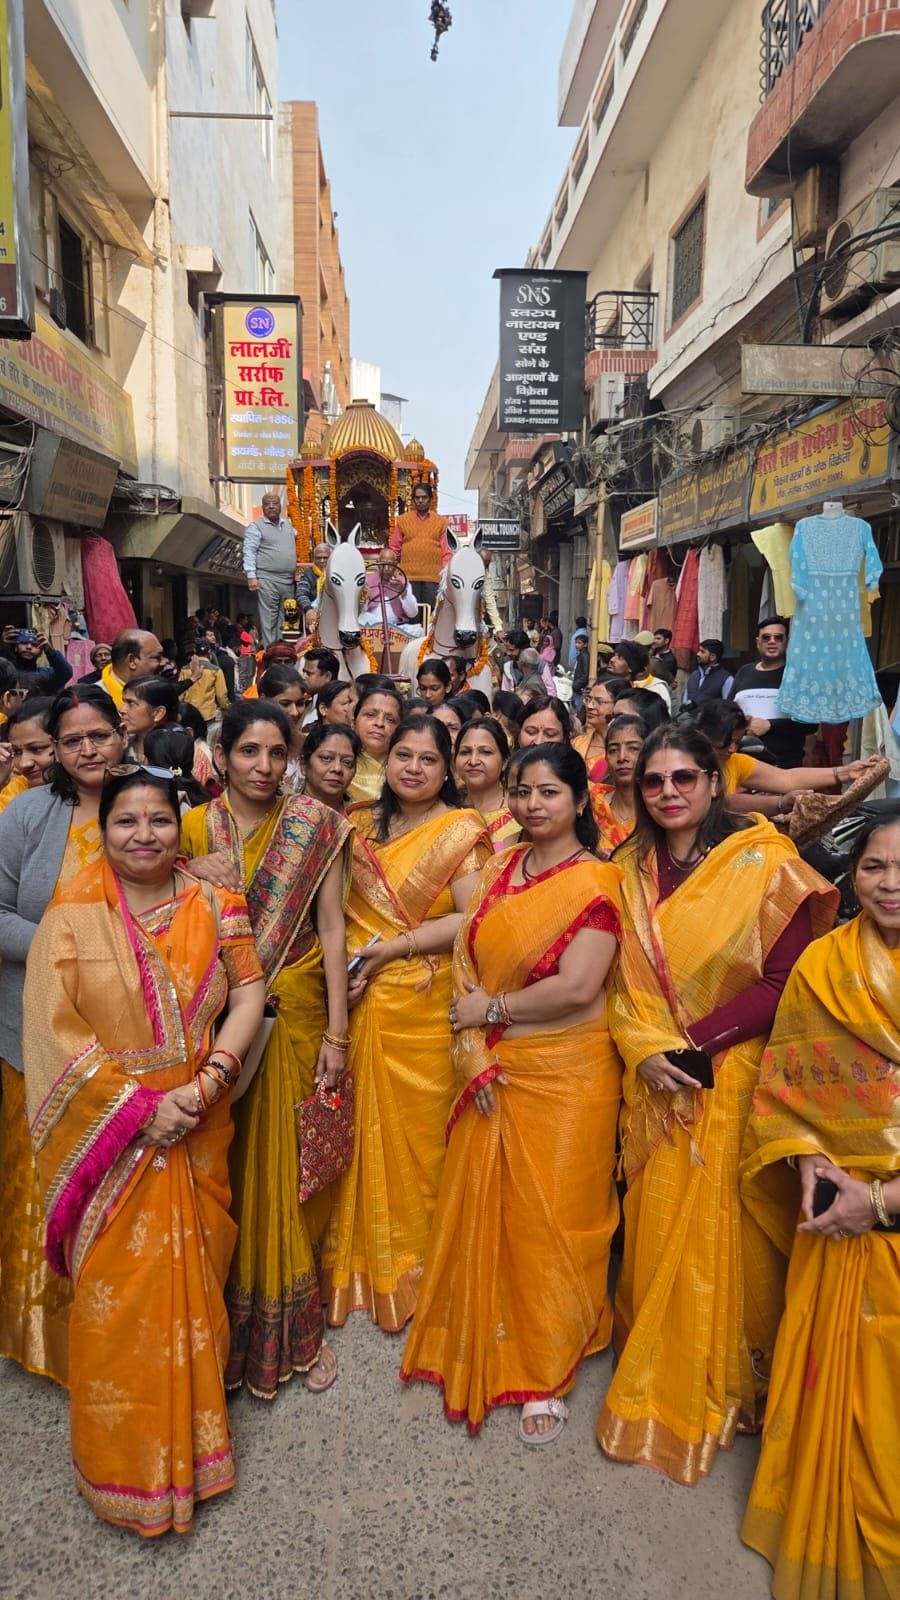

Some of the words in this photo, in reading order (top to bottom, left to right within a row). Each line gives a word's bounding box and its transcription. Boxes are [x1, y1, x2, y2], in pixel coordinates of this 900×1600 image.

[251, 317, 270, 329] SN
[228, 338, 293, 358] लालजी
[538, 358, 550, 368] के
[547, 372, 560, 382] के
